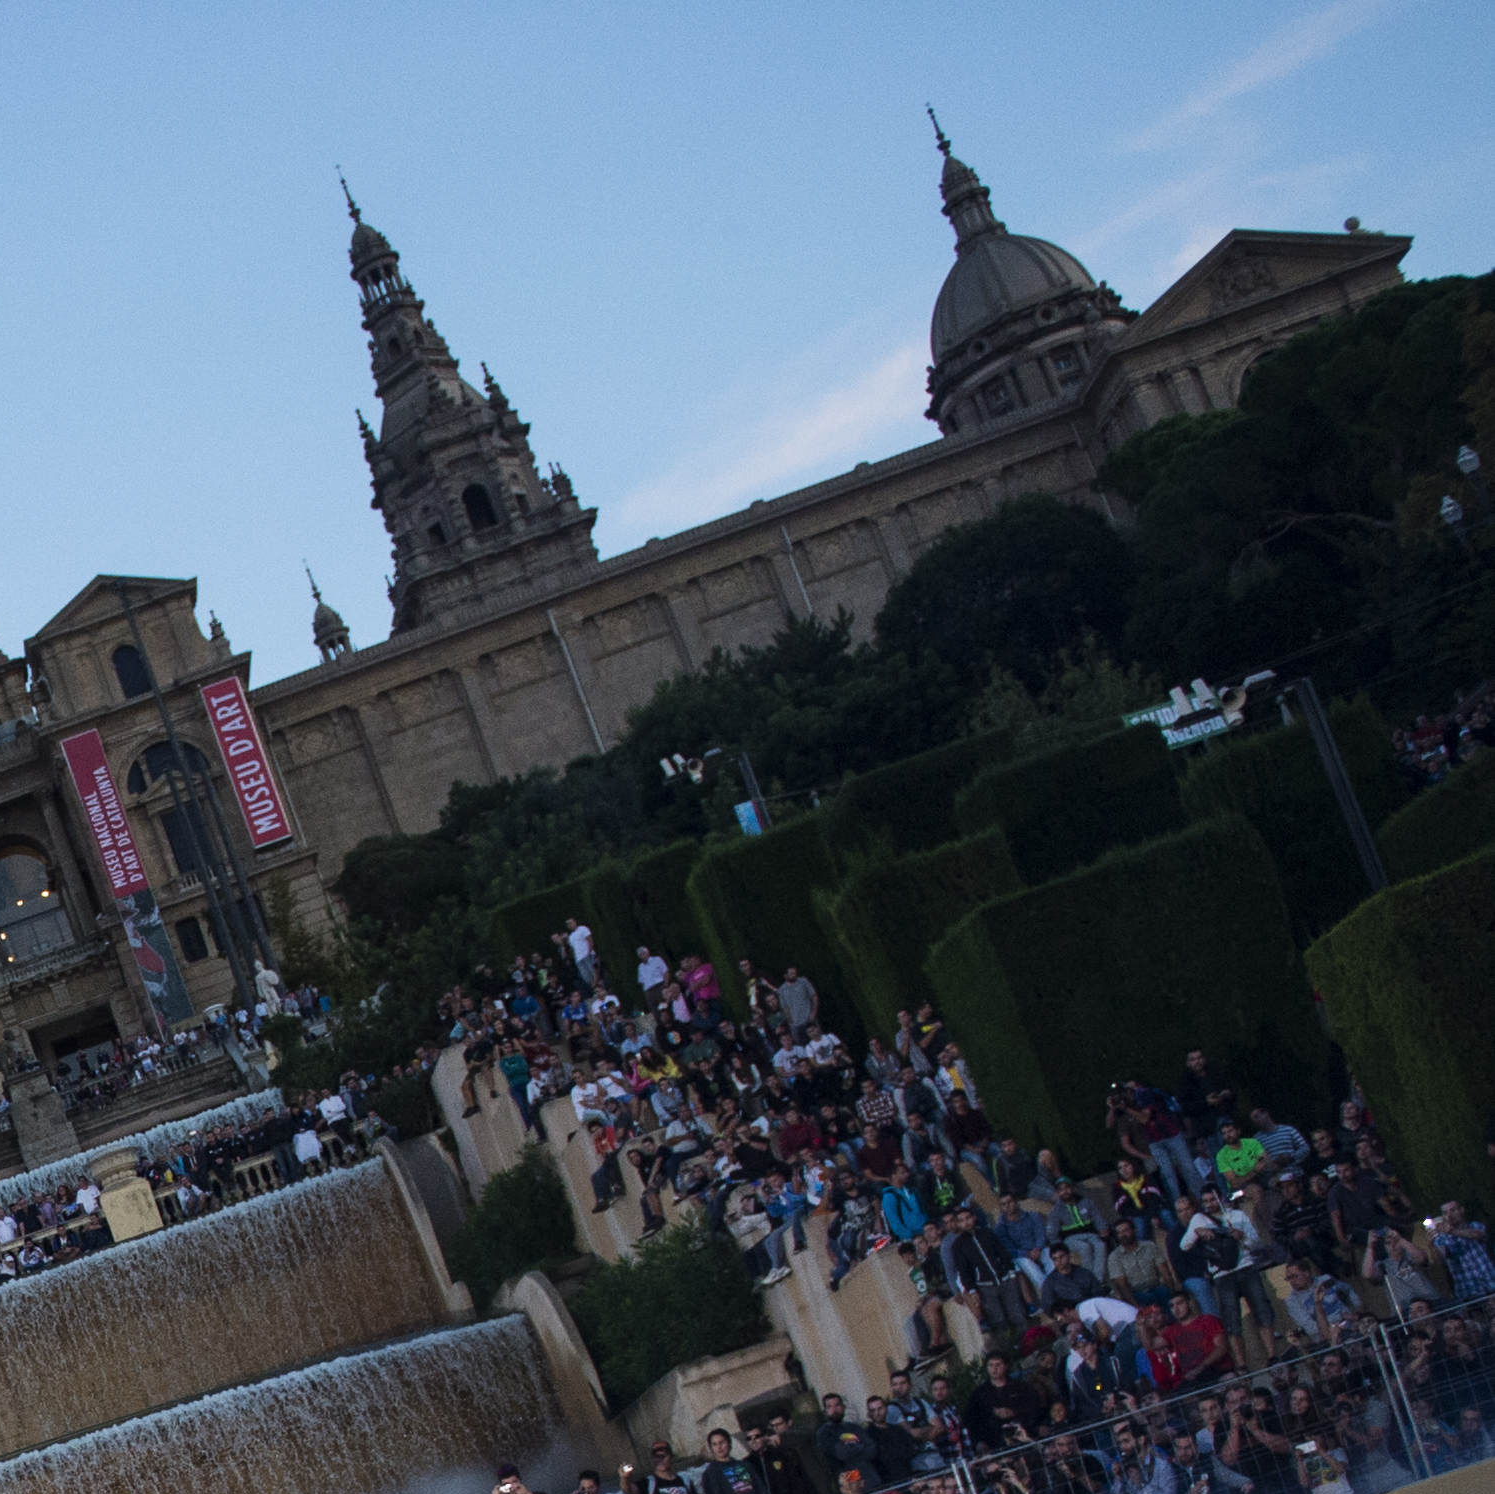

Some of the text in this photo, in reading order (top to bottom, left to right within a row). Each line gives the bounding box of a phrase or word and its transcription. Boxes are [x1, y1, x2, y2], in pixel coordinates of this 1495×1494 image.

[210, 692, 281, 835] MUSEU D'ART
[84, 791, 127, 889] MUSEU NACIONAL
[93, 765, 143, 883] D'ART DE CATALUNYA
